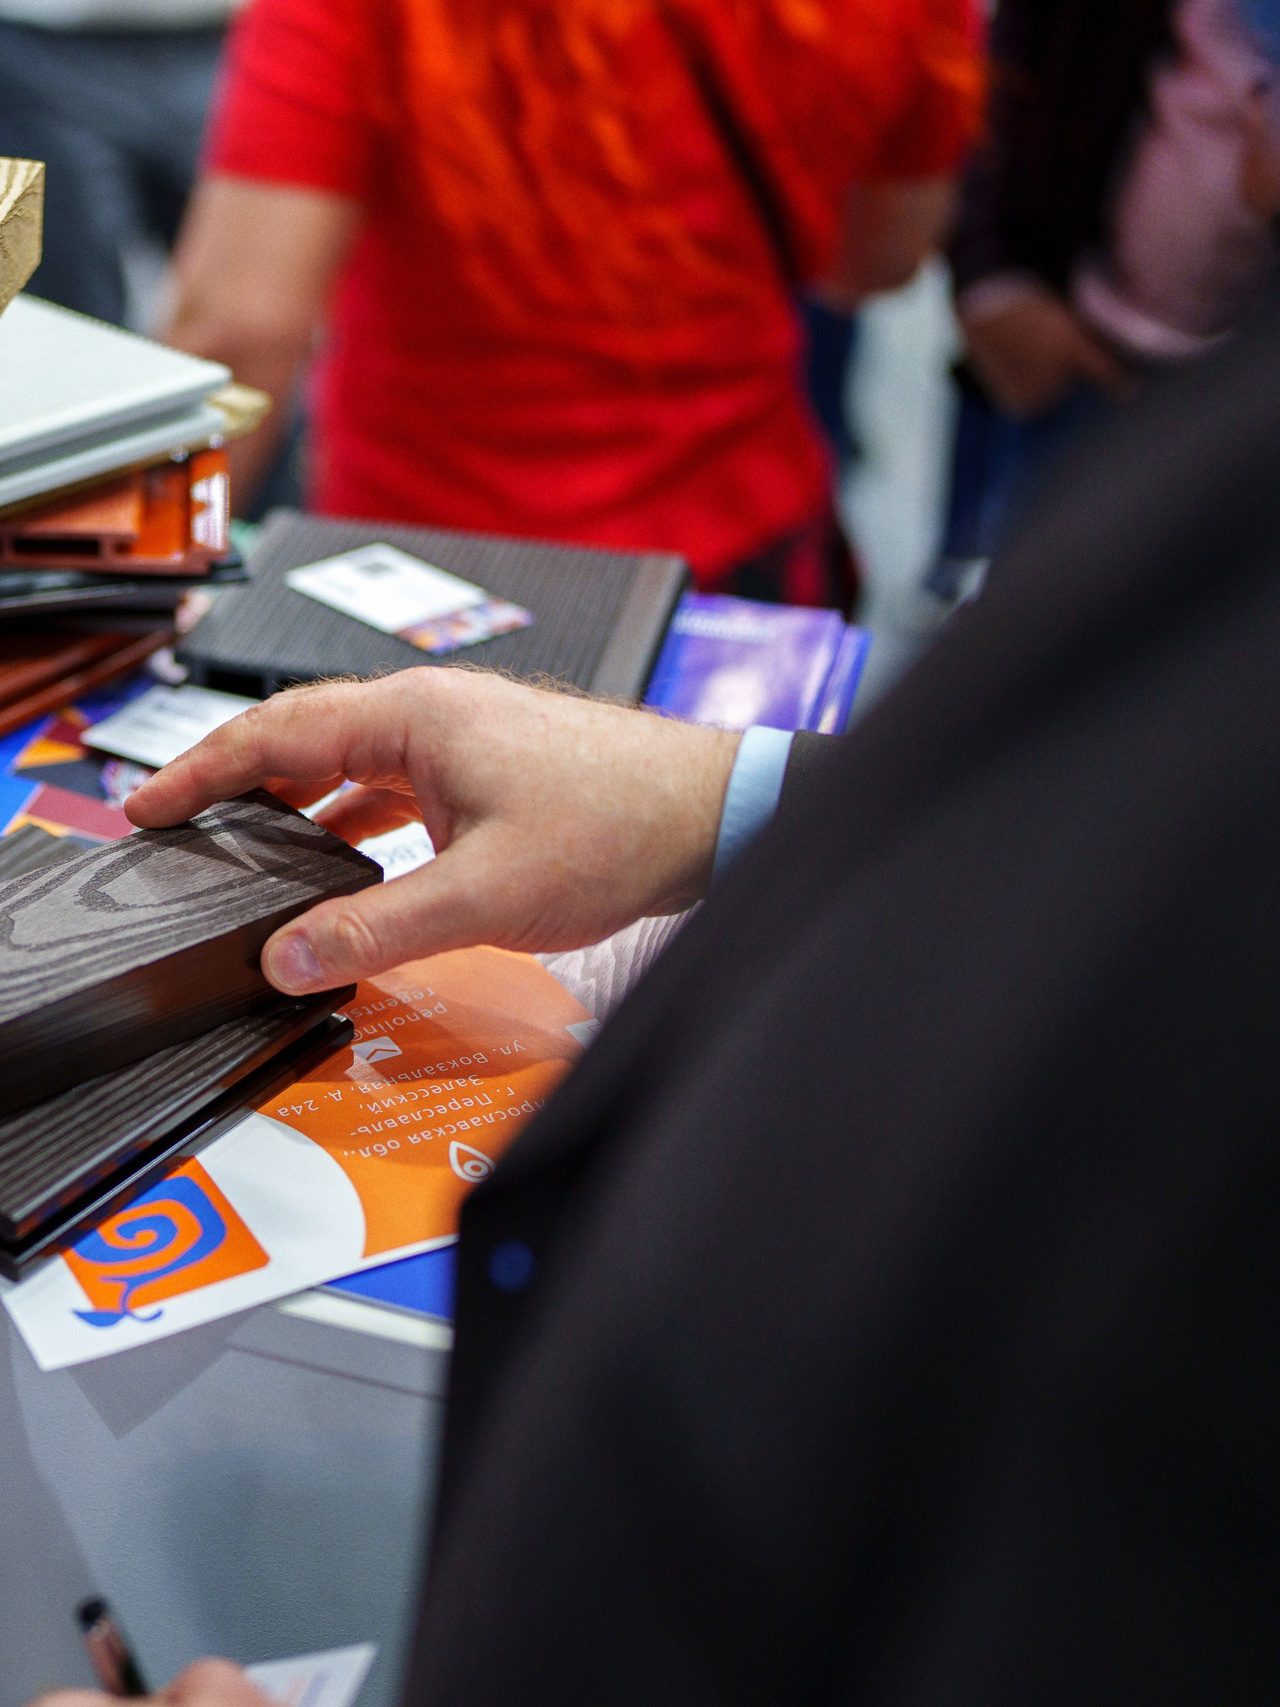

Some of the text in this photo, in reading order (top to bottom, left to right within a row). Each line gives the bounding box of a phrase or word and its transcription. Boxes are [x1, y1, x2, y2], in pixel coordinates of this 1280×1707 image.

[343, 987, 435, 1021] regents
[493, 1040, 526, 1056] ул.
[350, 1052, 489, 1095] Вокзальная,
[323, 1090, 343, 1102] д.
[350, 1086, 515, 1136] г. Переславль-
[359, 1074, 484, 1113] Залесский,
